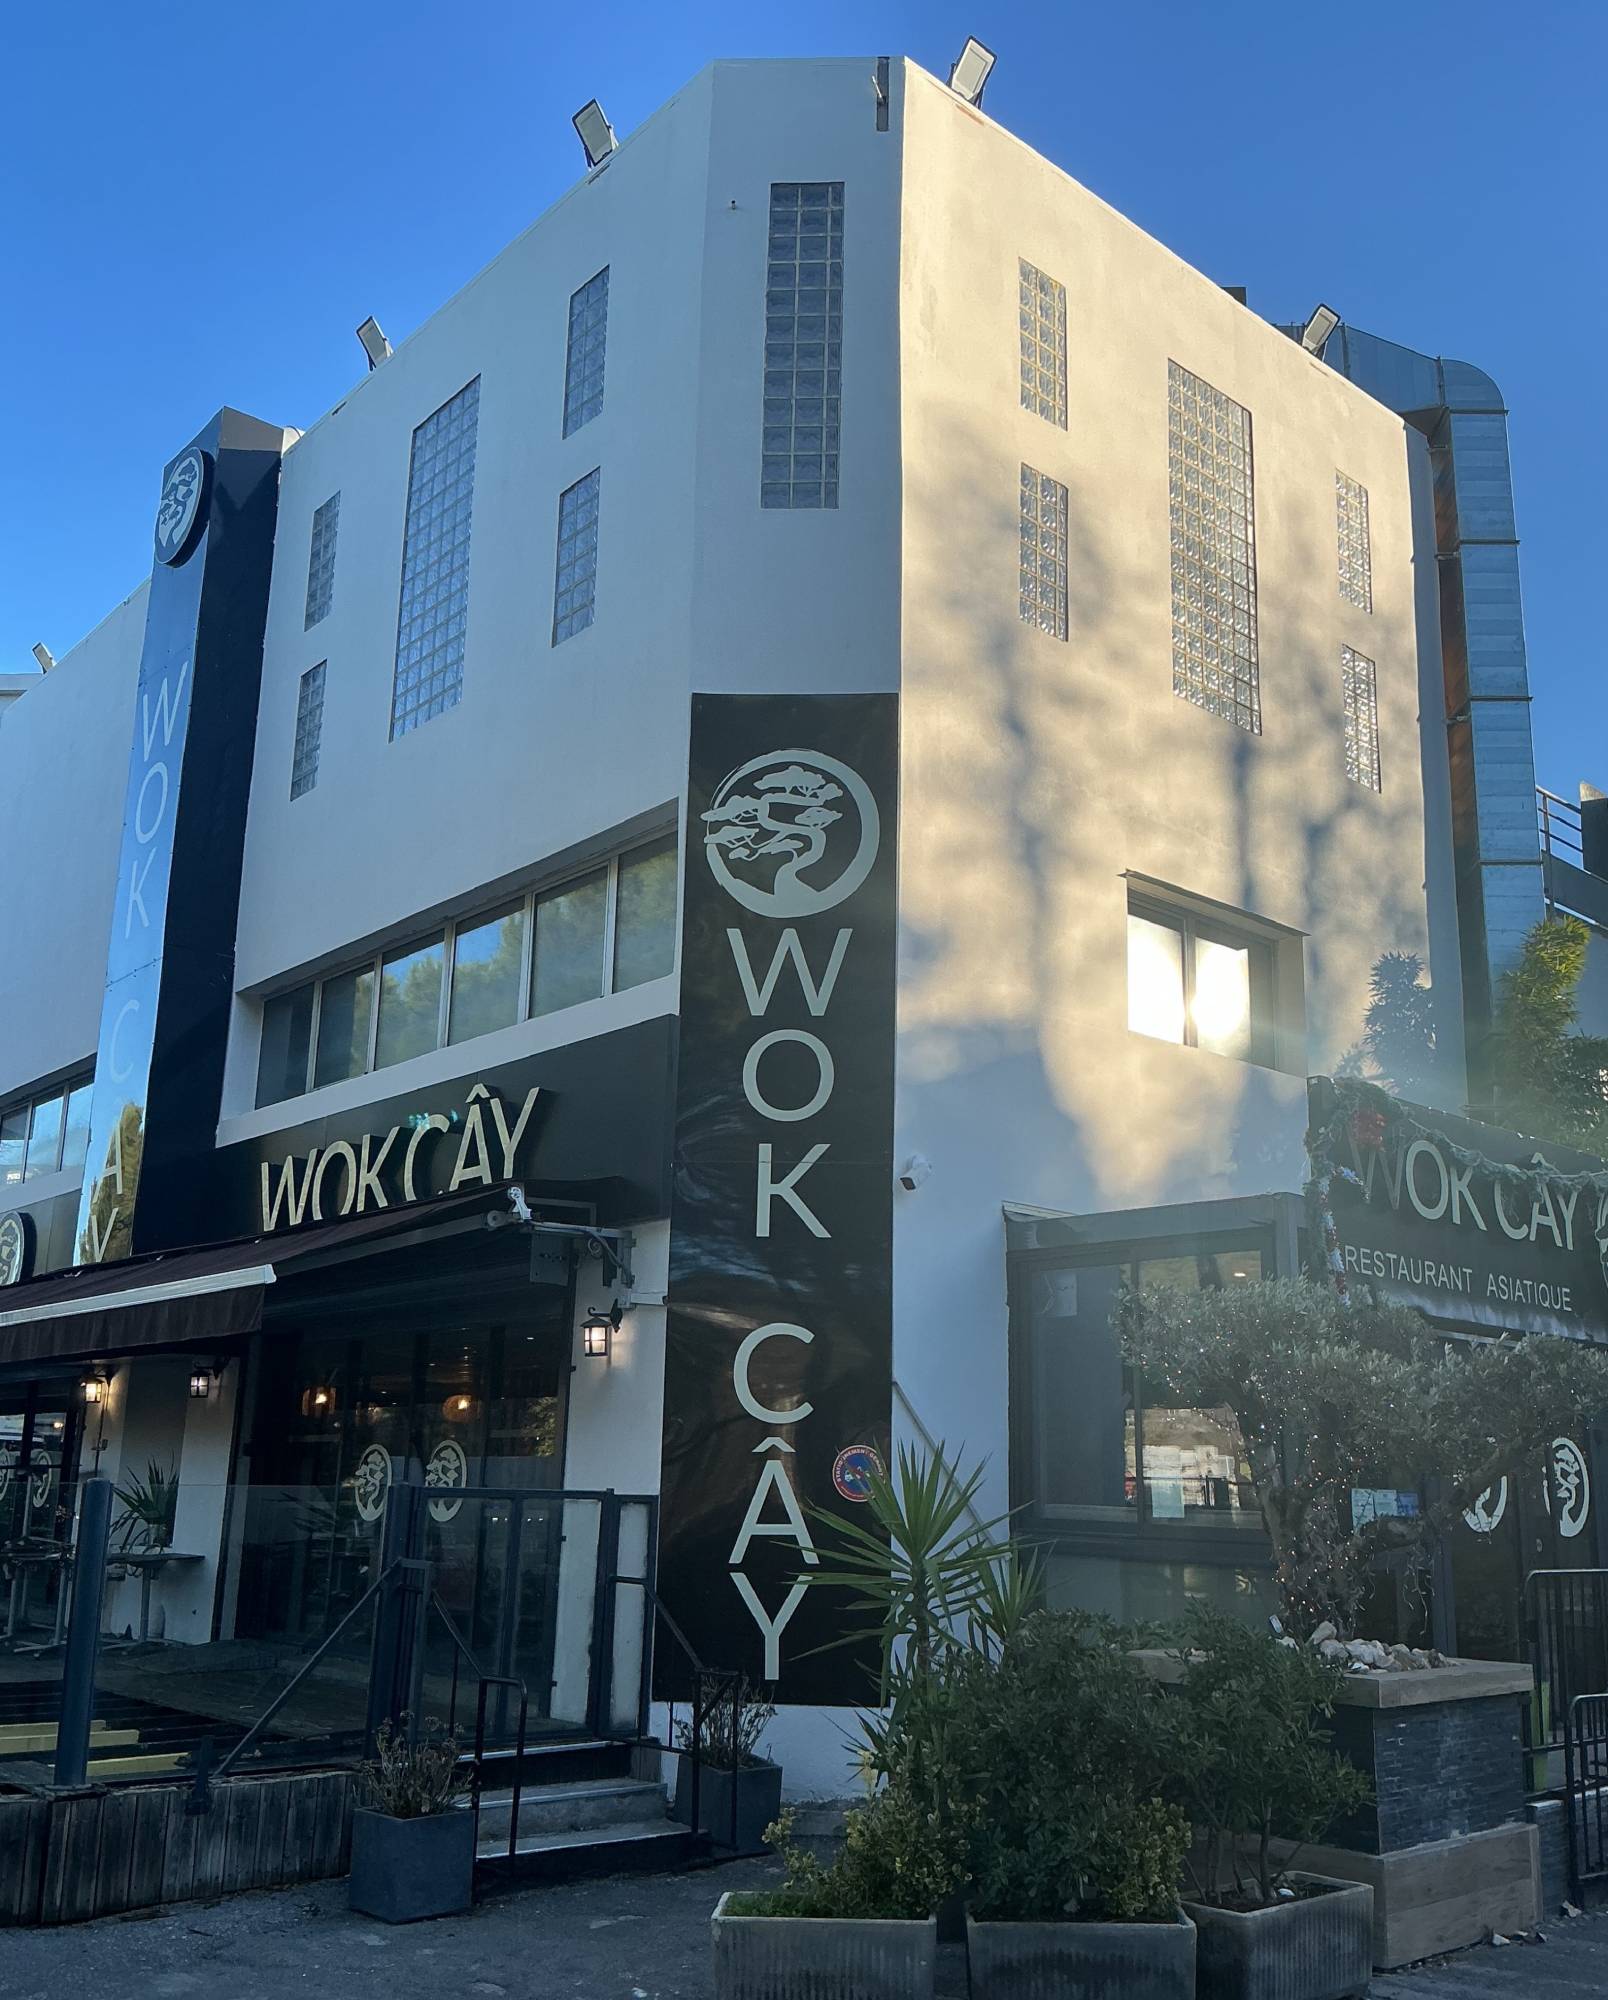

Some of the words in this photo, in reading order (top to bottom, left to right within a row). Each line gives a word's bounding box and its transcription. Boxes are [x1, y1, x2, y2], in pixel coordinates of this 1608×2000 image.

[124, 661, 188, 939] WOK
[726, 928, 853, 1238] WOK
[1344, 1245, 1473, 1294] RESTAURANT
[1487, 1273, 1573, 1312] ASIATIQUE
[731, 1322, 820, 1681] CÂY
